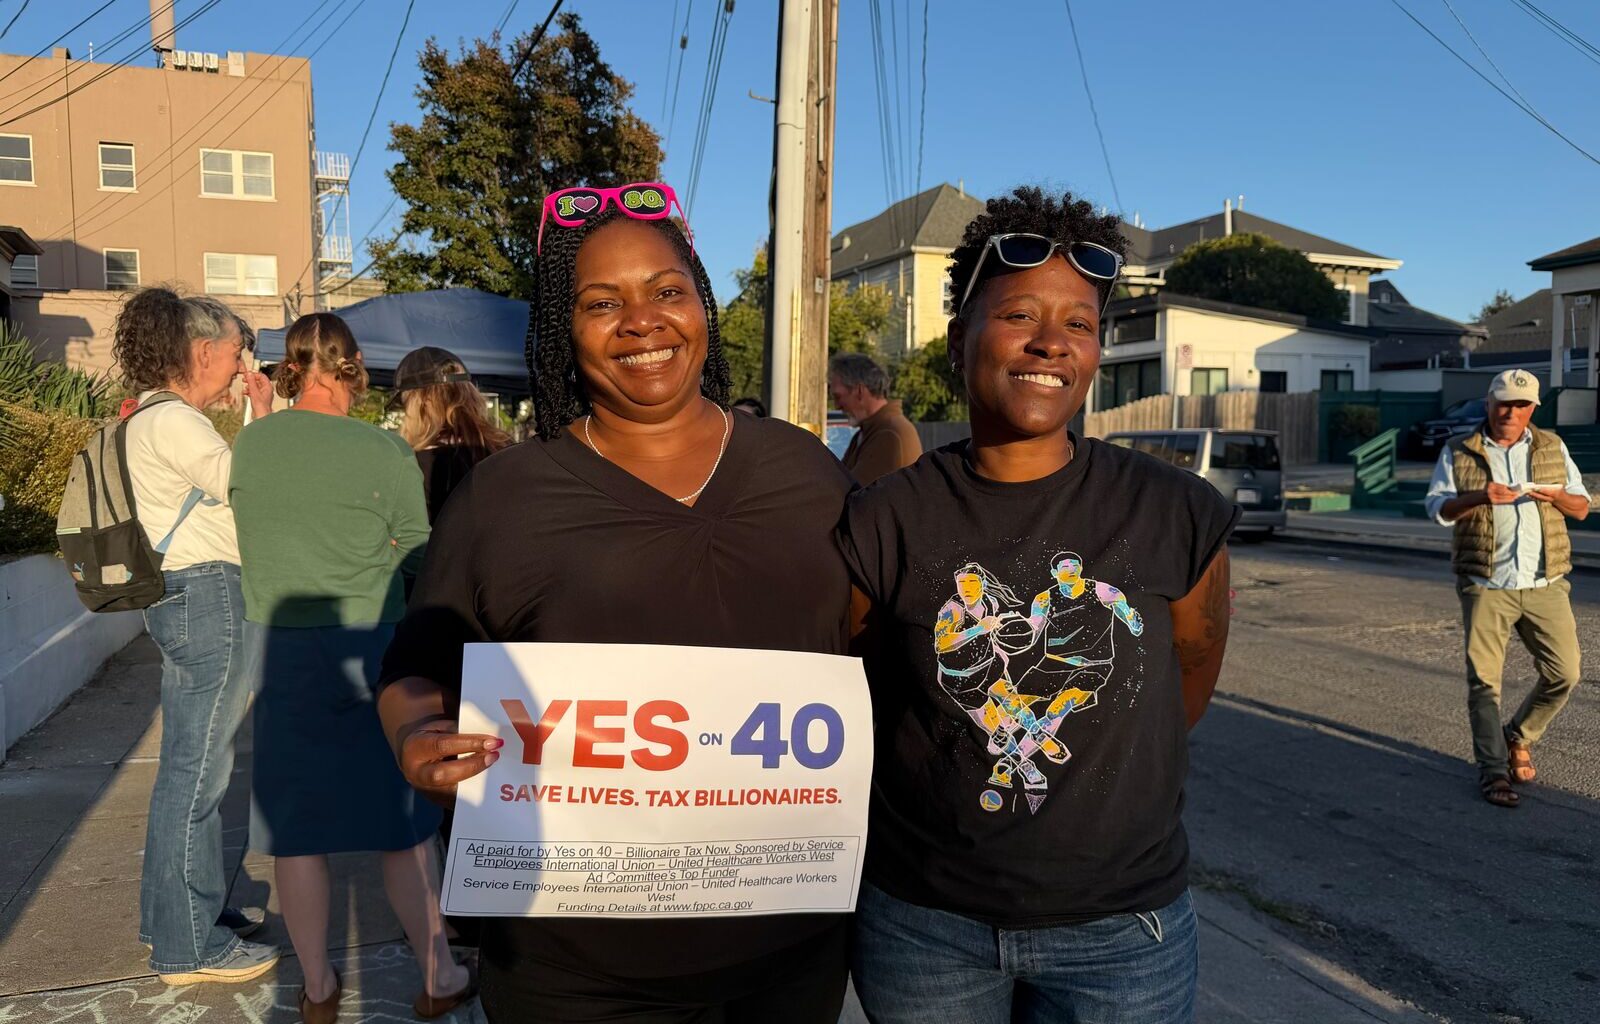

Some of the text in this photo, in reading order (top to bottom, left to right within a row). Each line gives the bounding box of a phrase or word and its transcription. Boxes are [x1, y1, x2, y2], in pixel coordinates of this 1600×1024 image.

[558, 195, 576, 217] I
[499, 699, 845, 771] YES ON 40
[500, 783, 843, 807] SAVE LIVES. TAX BILLIONAIRES.
[466, 842, 484, 854] Ad
[487, 845, 514, 857] paid
[517, 845, 534, 857] for
[536, 845, 551, 859] by
[554, 845, 576, 857] Yes
[578, 848, 593, 857] on
[596, 845, 612, 857] 40
[626, 846, 681, 858] Billionaire
[684, 845, 702, 857] Tax
[734, 841, 790, 856] Sponsored
[792, 840, 804, 852] by
[807, 839, 844, 851] Service
[474, 855, 543, 870] Employees
[546, 859, 618, 871] International
[621, 860, 655, 871] Union
[669, 858, 704, 869] United
[706, 854, 763, 867] Healthcare
[766, 851, 807, 863] Workers
[809, 849, 835, 861] West
[463, 877, 509, 891] Service
[512, 880, 580, 895] Employees
[583, 880, 654, 893] International
[657, 880, 689, 892] Union
[702, 878, 736, 889] United
[739, 872, 793, 887] Healthcare
[796, 872, 838, 884] Workers
[586, 867, 740, 884] Ad Committee's Top Funder
[557, 900, 753, 913] Funding Details at www.fppc.ca.gov
[647, 892, 676, 902] West
